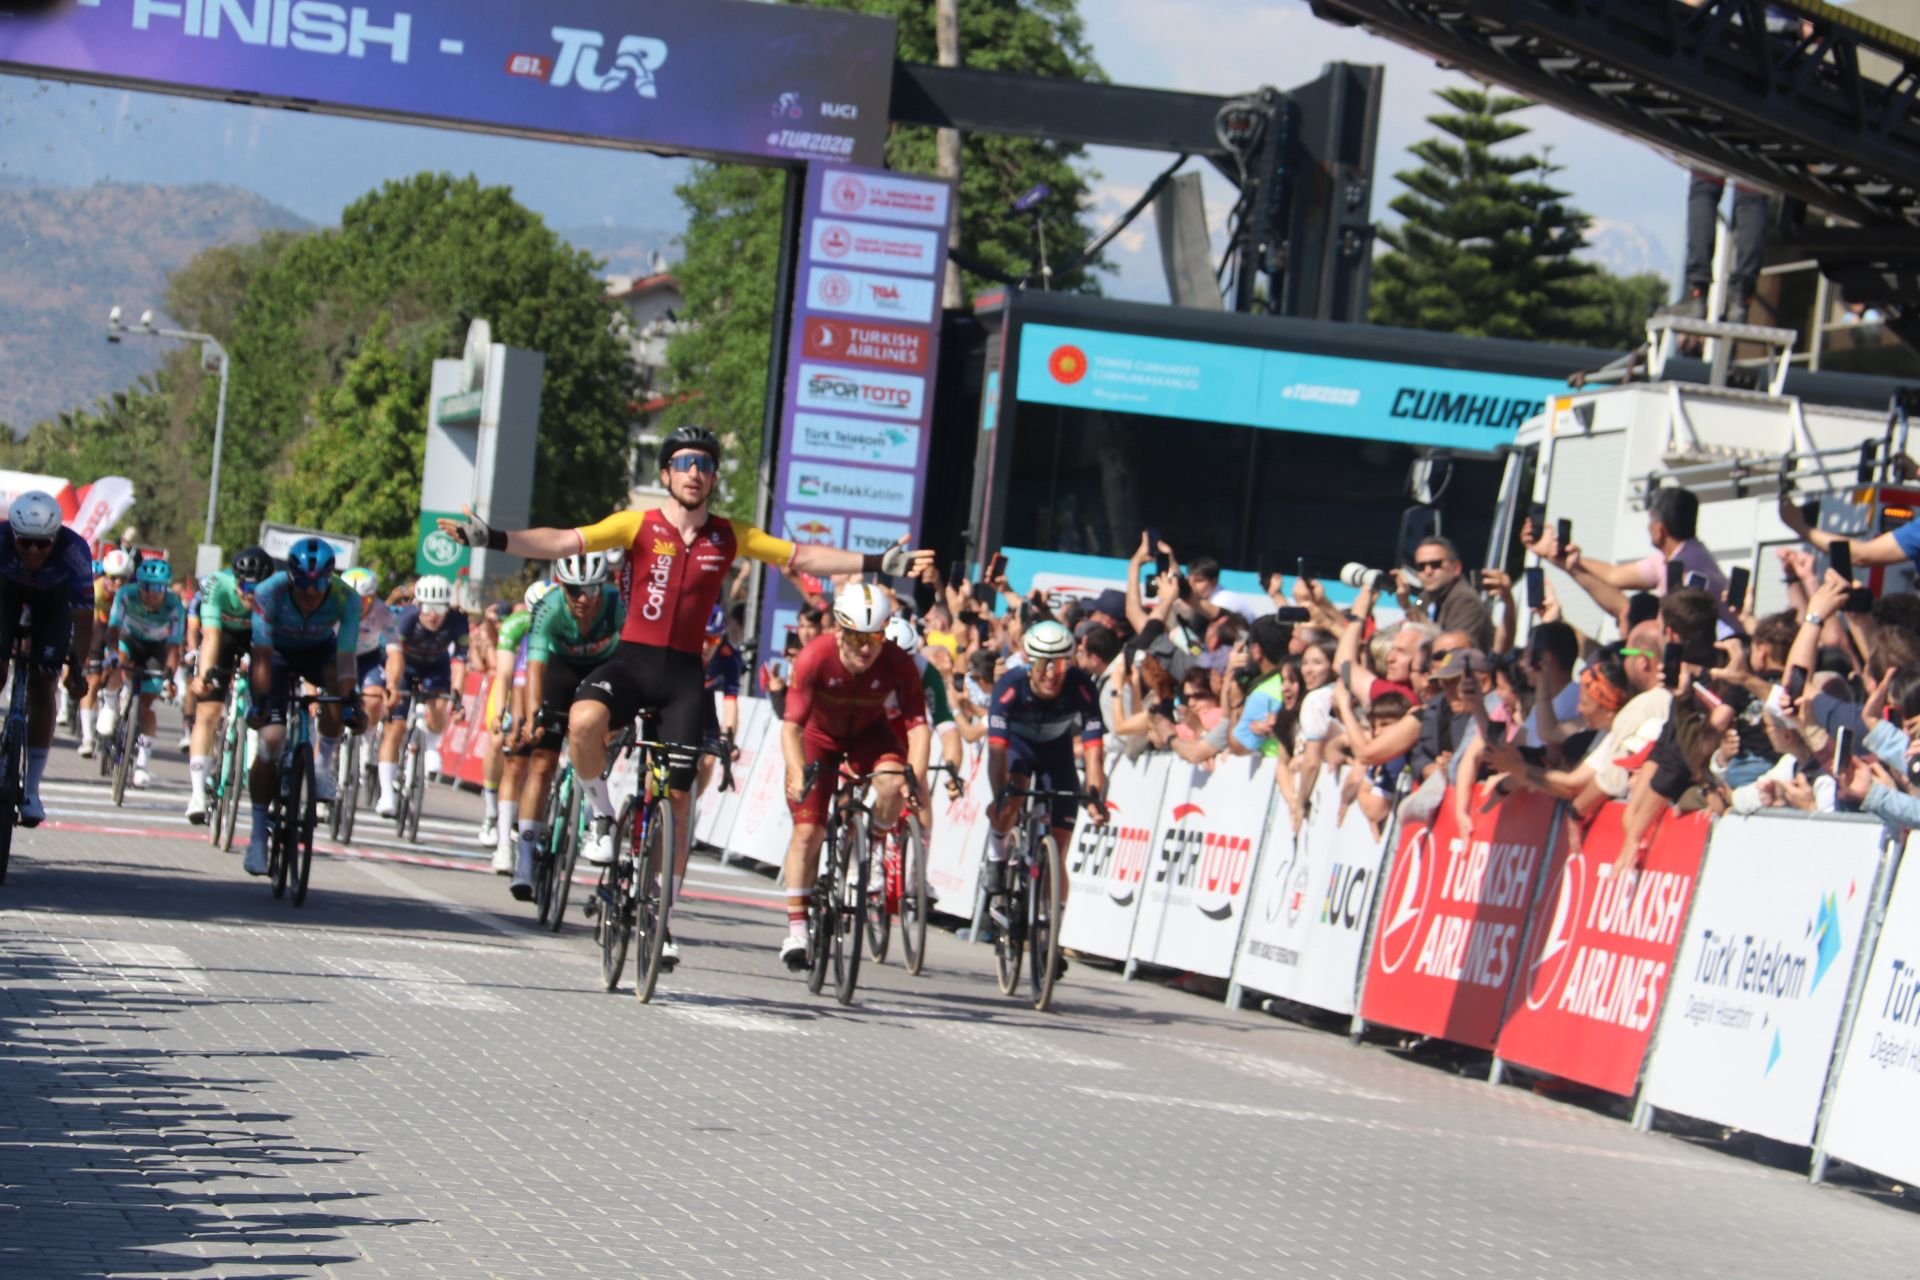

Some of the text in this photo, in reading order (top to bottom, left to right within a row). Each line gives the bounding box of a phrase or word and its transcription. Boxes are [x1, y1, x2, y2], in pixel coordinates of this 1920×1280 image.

[133, 0, 411, 63] FINISH
[845, 343, 918, 364] AIRLINES
[848, 328, 920, 348] TURKISH
[643, 554, 672, 621] Cofidis
[1330, 864, 1372, 931] UCI
[1440, 837, 1537, 910] TURKISH
[1586, 862, 1691, 945] TURKISH
[1414, 913, 1517, 989] AIRLINES
[1694, 929, 1807, 999] Türk Telekom
[1557, 945, 1667, 1032] AIRLINES
